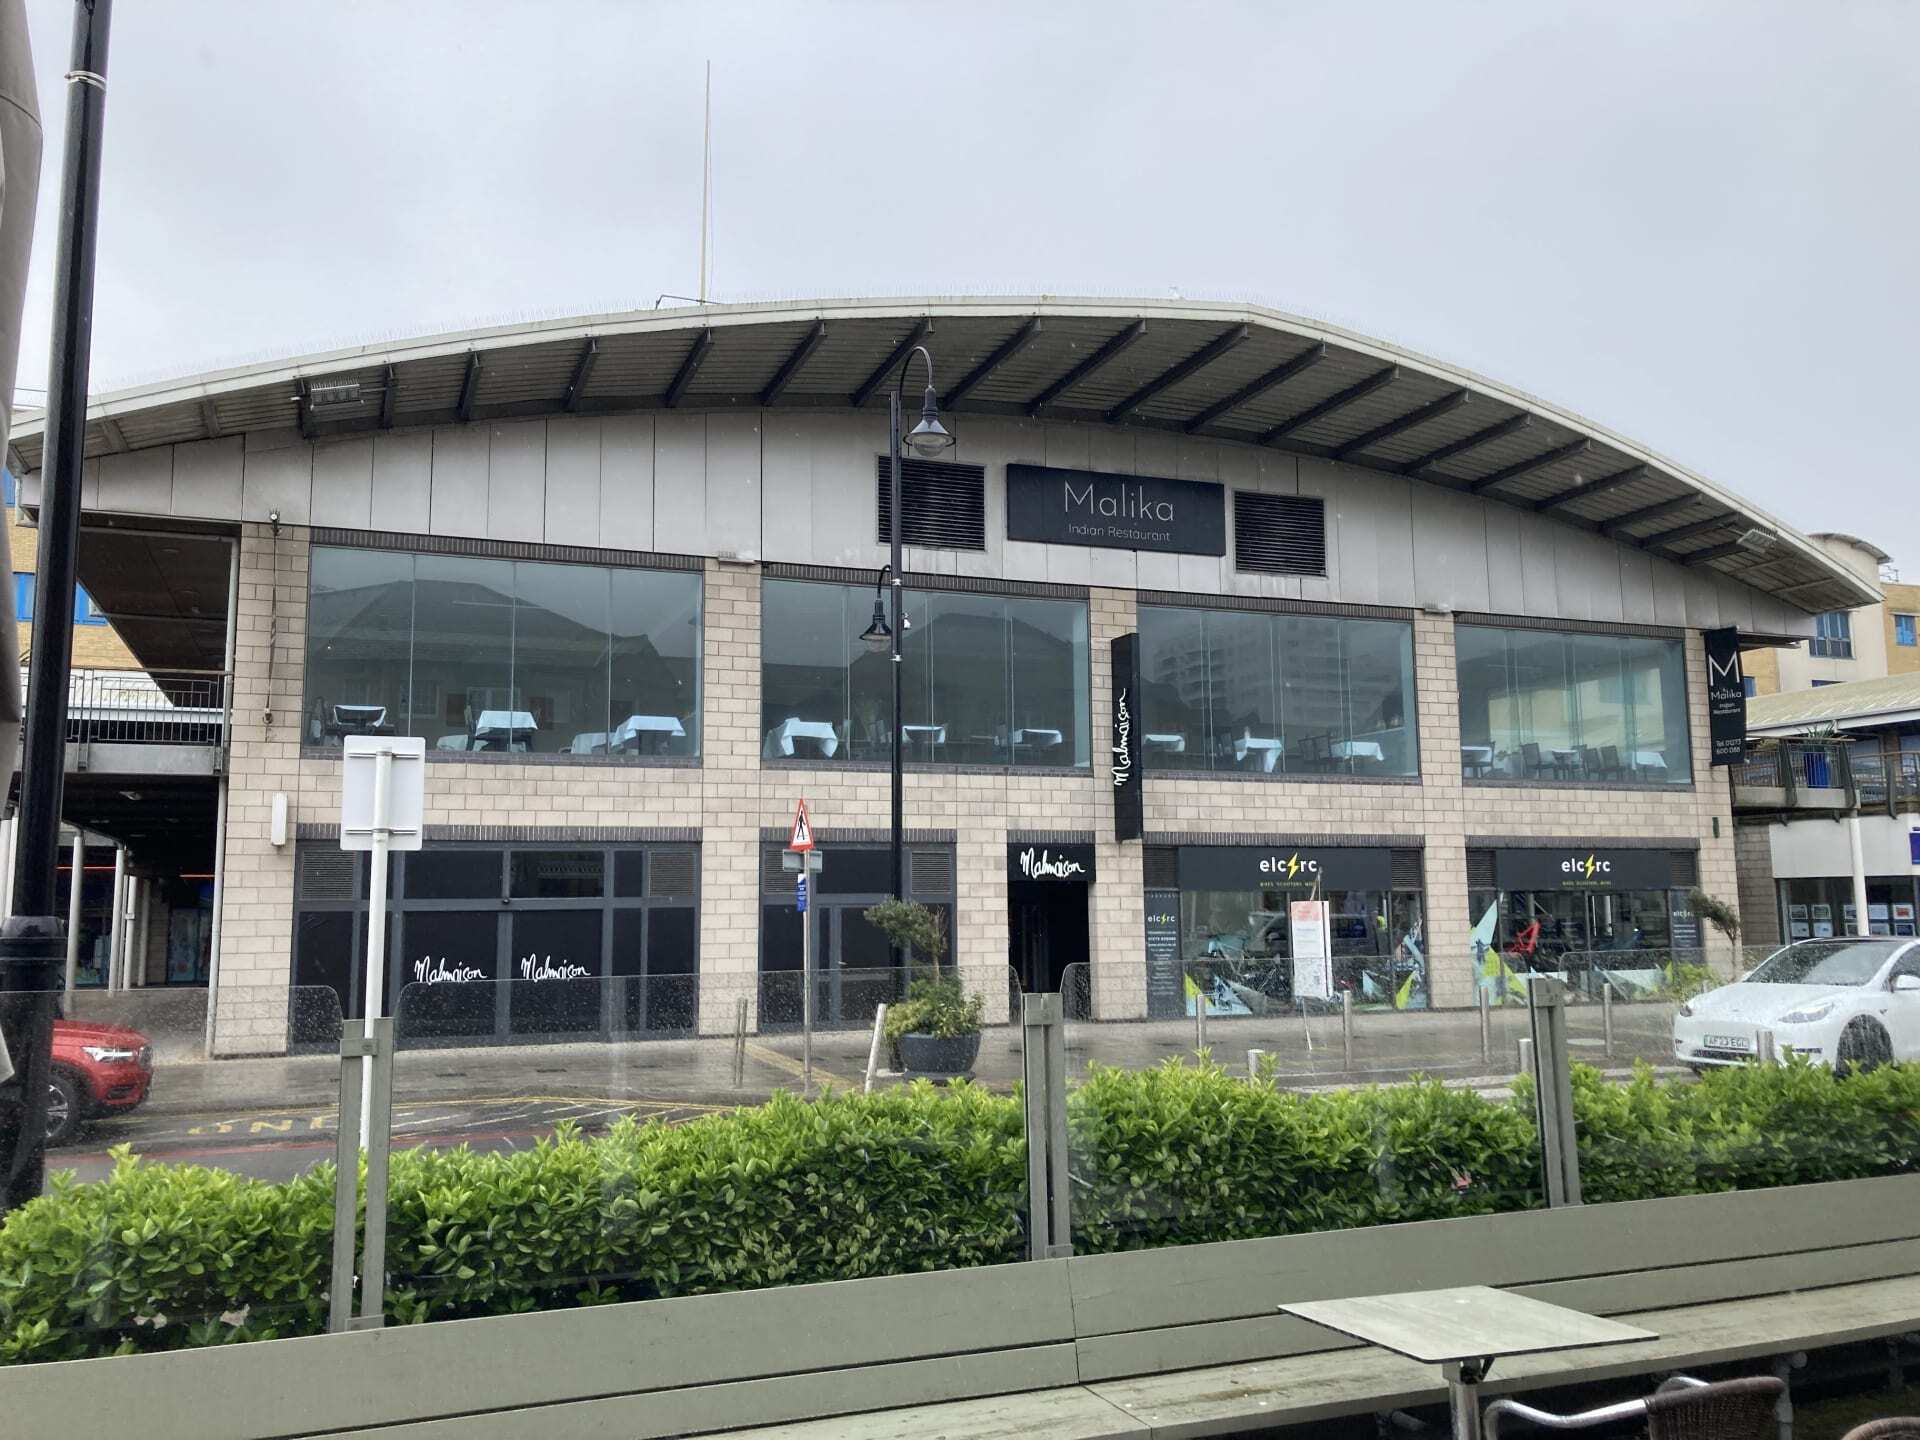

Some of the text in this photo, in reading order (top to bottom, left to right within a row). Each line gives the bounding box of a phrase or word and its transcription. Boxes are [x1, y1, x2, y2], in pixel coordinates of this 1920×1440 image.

[1064, 480, 1173, 521] Malika
[1068, 523, 1171, 541] Indian Restaurant
[1708, 650, 1740, 687] M
[1711, 687, 1742, 700] Malika
[1111, 687, 1132, 786] Malmaison
[1020, 847, 1086, 879] Malmaison
[413, 955, 488, 986] Malmaison
[520, 953, 592, 983] Malmaison
